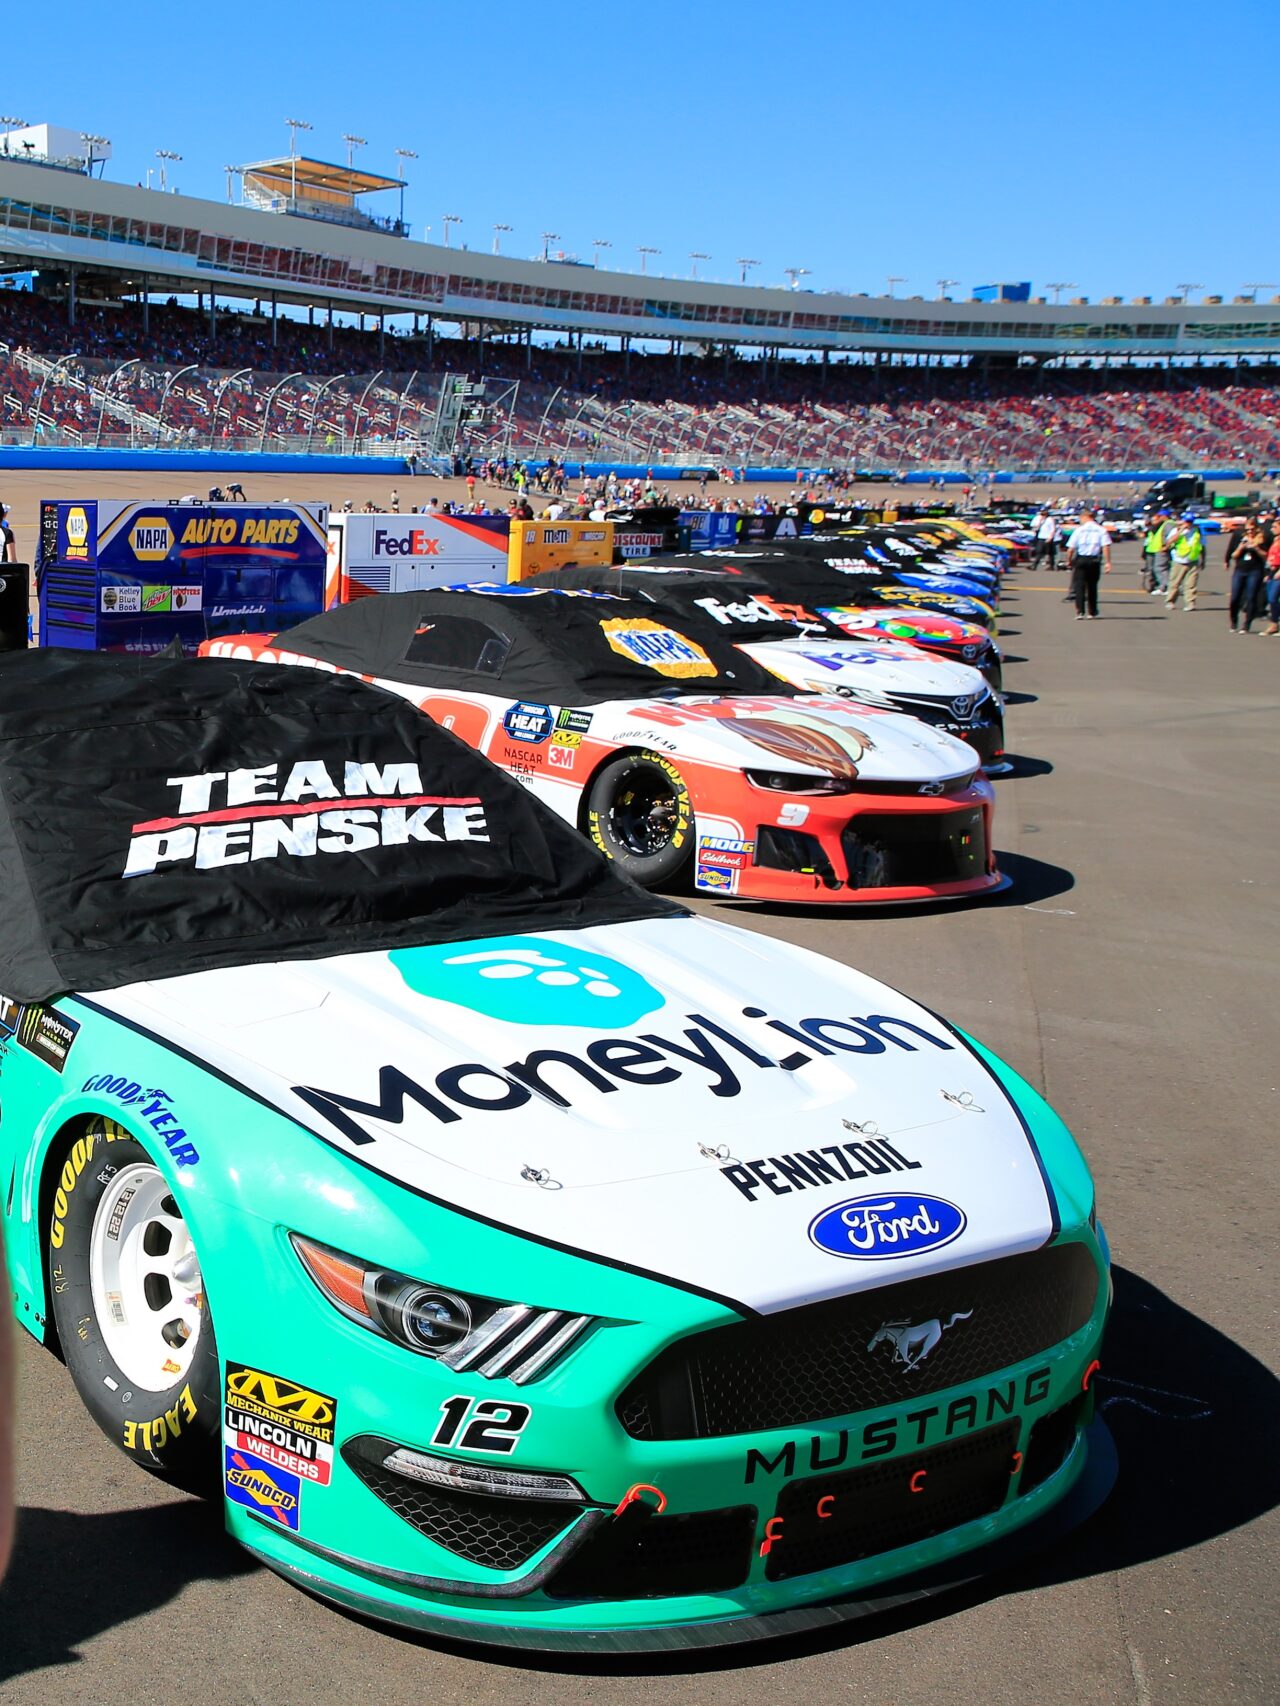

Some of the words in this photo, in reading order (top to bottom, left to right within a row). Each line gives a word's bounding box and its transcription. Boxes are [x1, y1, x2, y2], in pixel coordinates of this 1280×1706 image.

[136, 529, 167, 549] NAPA
[181, 518, 237, 544] AUTO
[240, 519, 301, 544] PARTS
[374, 530, 439, 556] FedEx
[613, 534, 664, 547] DISCOUNT
[624, 548, 648, 556] TIRE
[119, 588, 140, 596] Kelley
[693, 594, 821, 625] FedEx
[616, 633, 702, 662] NAPA
[510, 713, 547, 733] HEAT
[504, 747, 543, 764] NASCAR
[510, 761, 536, 776] HEAT
[549, 746, 573, 768] 3M
[166, 760, 424, 814] TEAM
[776, 803, 810, 827] 9
[121, 806, 490, 879] PENSKE
[701, 836, 754, 853] MOOG
[701, 853, 742, 866] Edelbrock
[700, 873, 731, 883] SUNOCO
[41, 1014, 74, 1042] MONSTER
[42, 1029, 65, 1046] ENERGY
[290, 1005, 956, 1146] MoneyLion
[720, 1138, 922, 1202] PENNZOIL
[841, 1203, 940, 1250] Ford
[124, 1382, 198, 1451] EAGLE
[227, 1391, 291, 1428] MECHANIX
[293, 1420, 333, 1443] WEAR
[431, 1397, 531, 1454] 12
[745, 1368, 1051, 1484] MUSTANG
[228, 1411, 312, 1458] LINCOLN
[246, 1436, 319, 1479] WELDERS
[230, 1470, 293, 1508] SUNOCO
